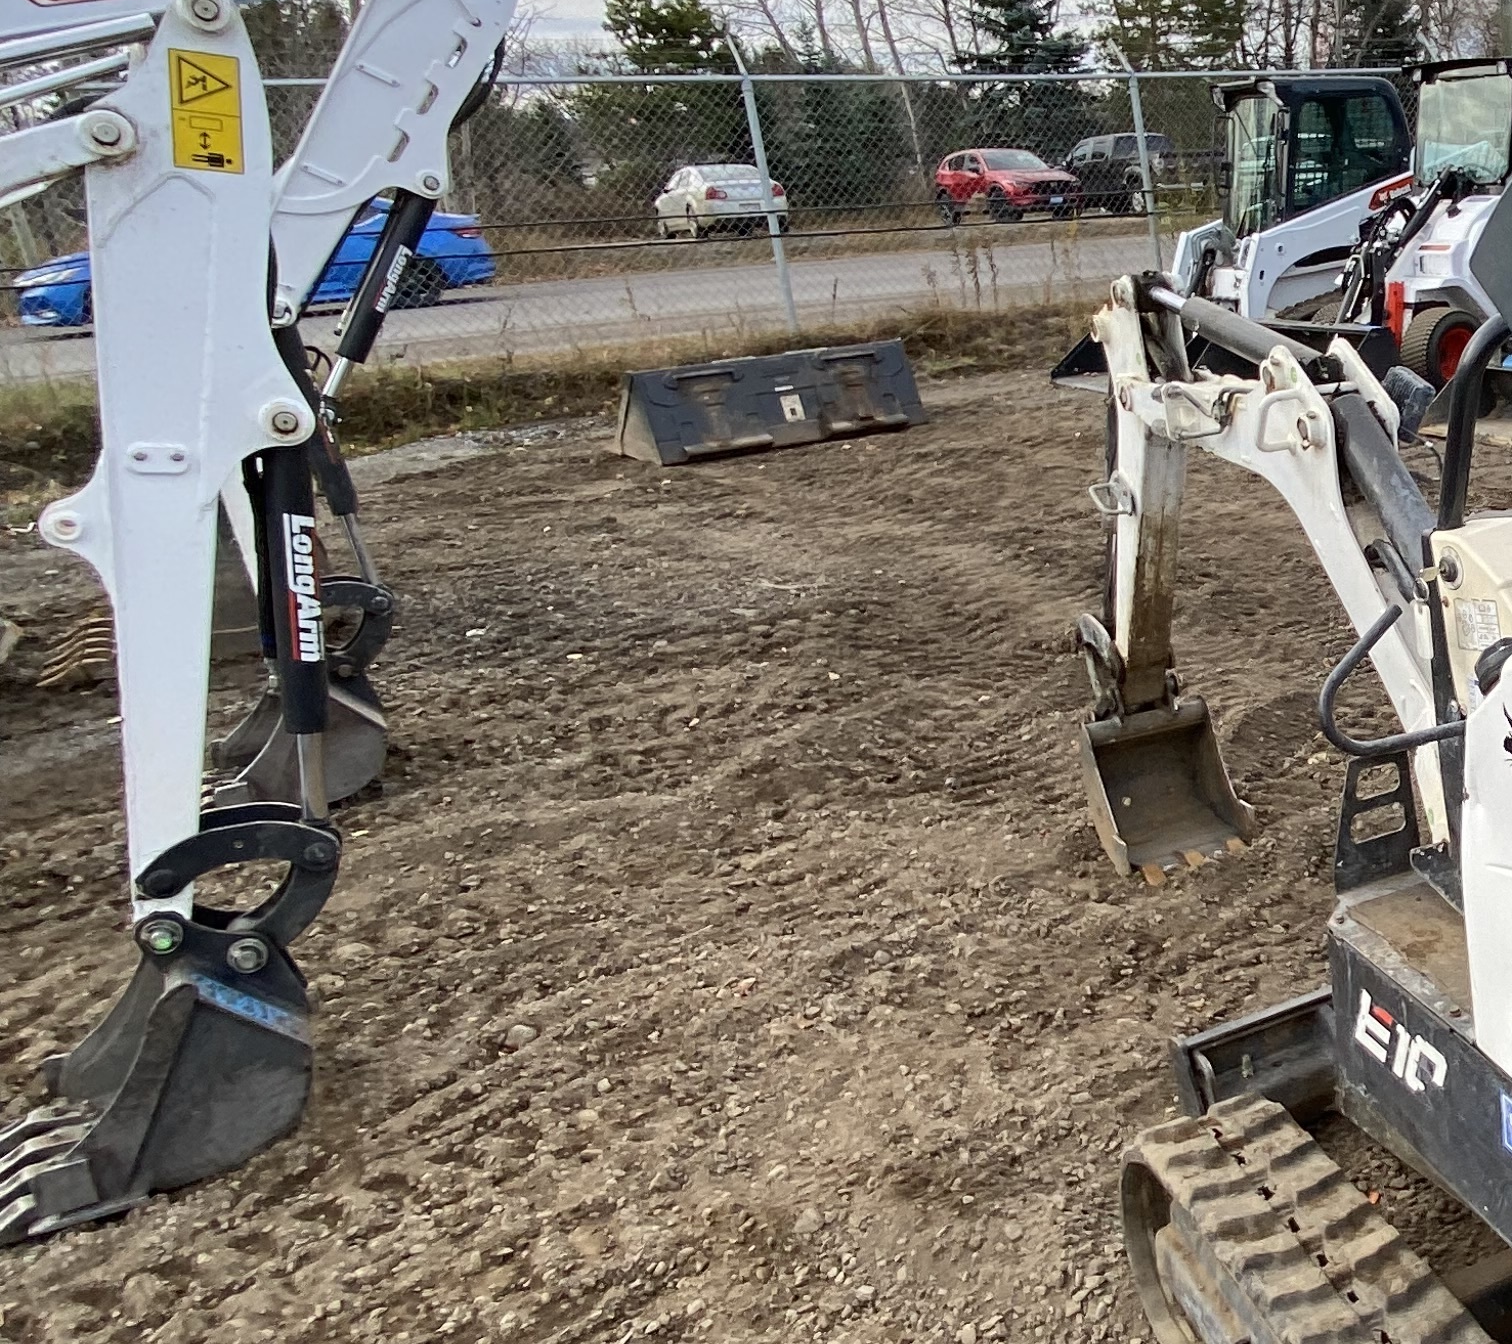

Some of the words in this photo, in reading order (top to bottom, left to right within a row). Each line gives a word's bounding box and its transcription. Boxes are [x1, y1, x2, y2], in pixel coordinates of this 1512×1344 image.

[375, 244, 413, 313] LongArm
[283, 512, 326, 663] LongArm
[1354, 988, 1449, 1093] E10
